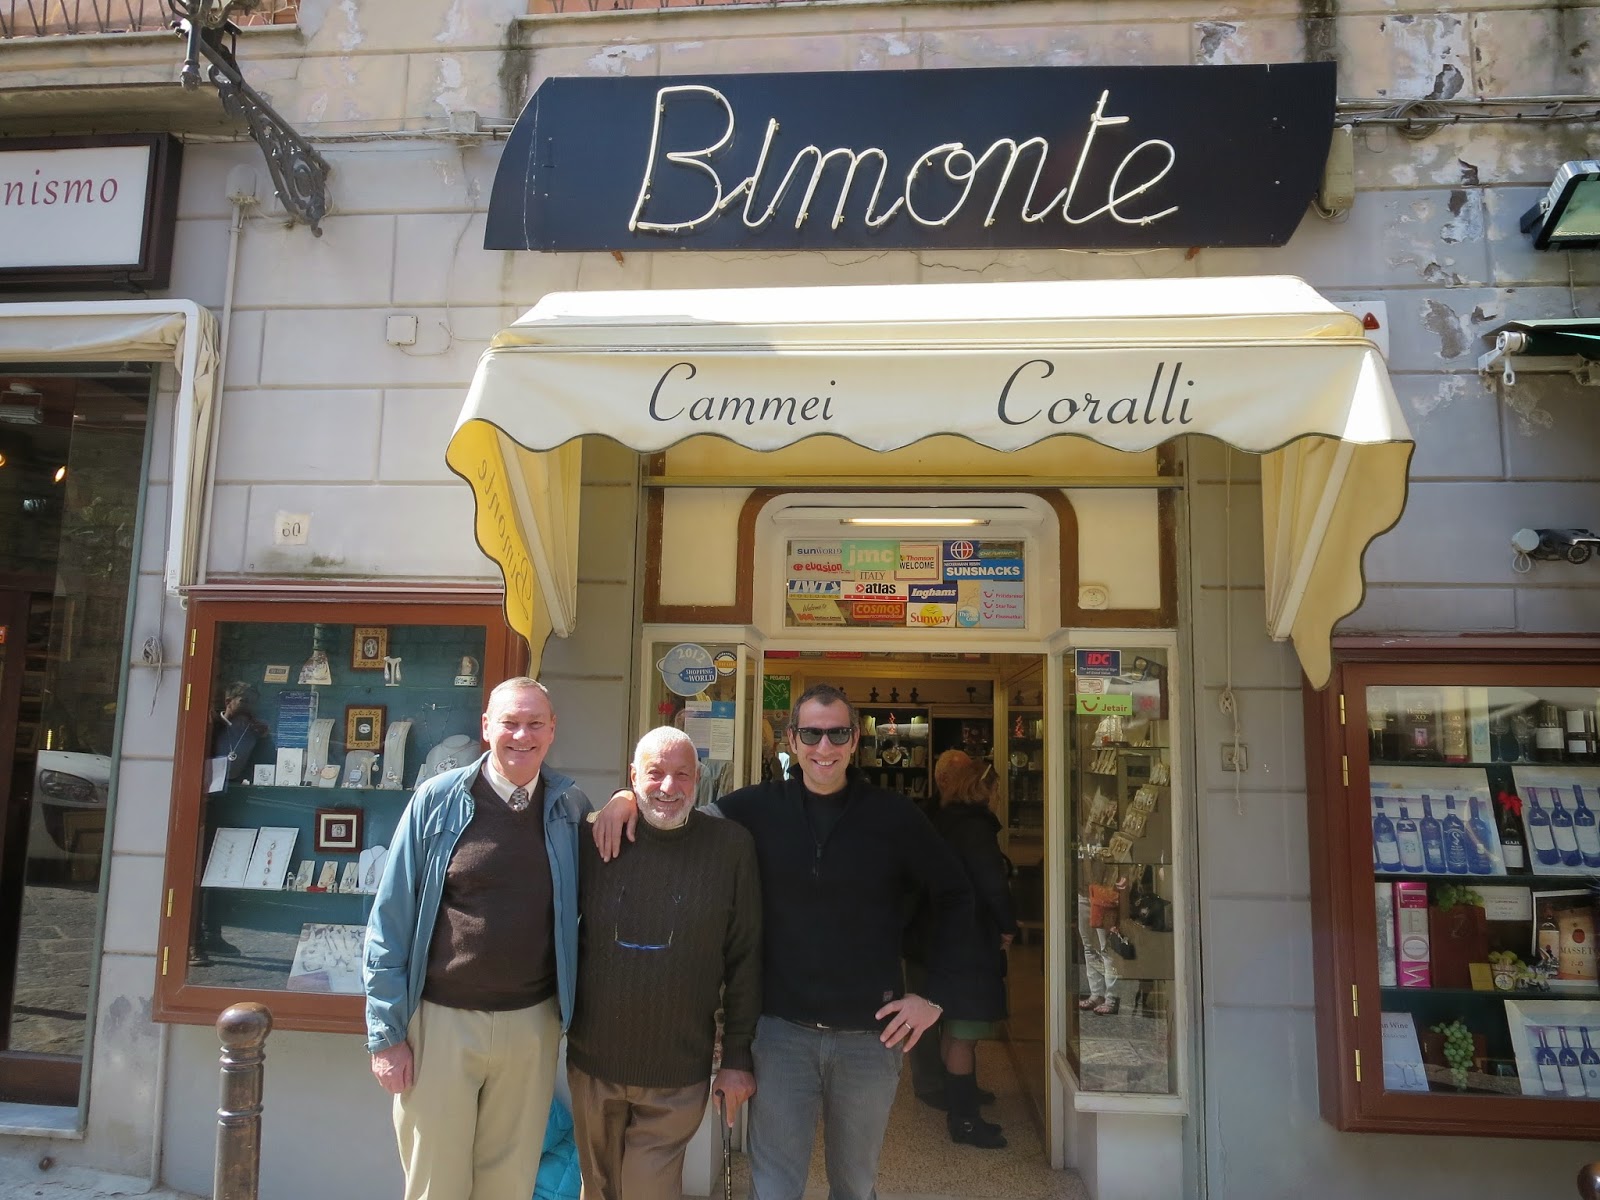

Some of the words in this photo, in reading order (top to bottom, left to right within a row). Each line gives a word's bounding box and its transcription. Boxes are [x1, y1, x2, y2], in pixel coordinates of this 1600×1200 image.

[4, 169, 118, 206] nismo
[648, 362, 836, 426] Cammei
[997, 359, 1195, 425] Coralli
[847, 545, 894, 566] jmc
[805, 562, 842, 572] evasion
[900, 561, 934, 569] WELCOME
[860, 571, 886, 580] ITALY
[946, 566, 1020, 577] SUNSNACKS
[866, 582, 896, 594] atlas
[911, 588, 956, 599] Inghams
[856, 604, 901, 614] cosmos
[910, 612, 953, 625] Sunway
[689, 674, 715, 682] WORLD
[1102, 704, 1127, 712] Jetair
